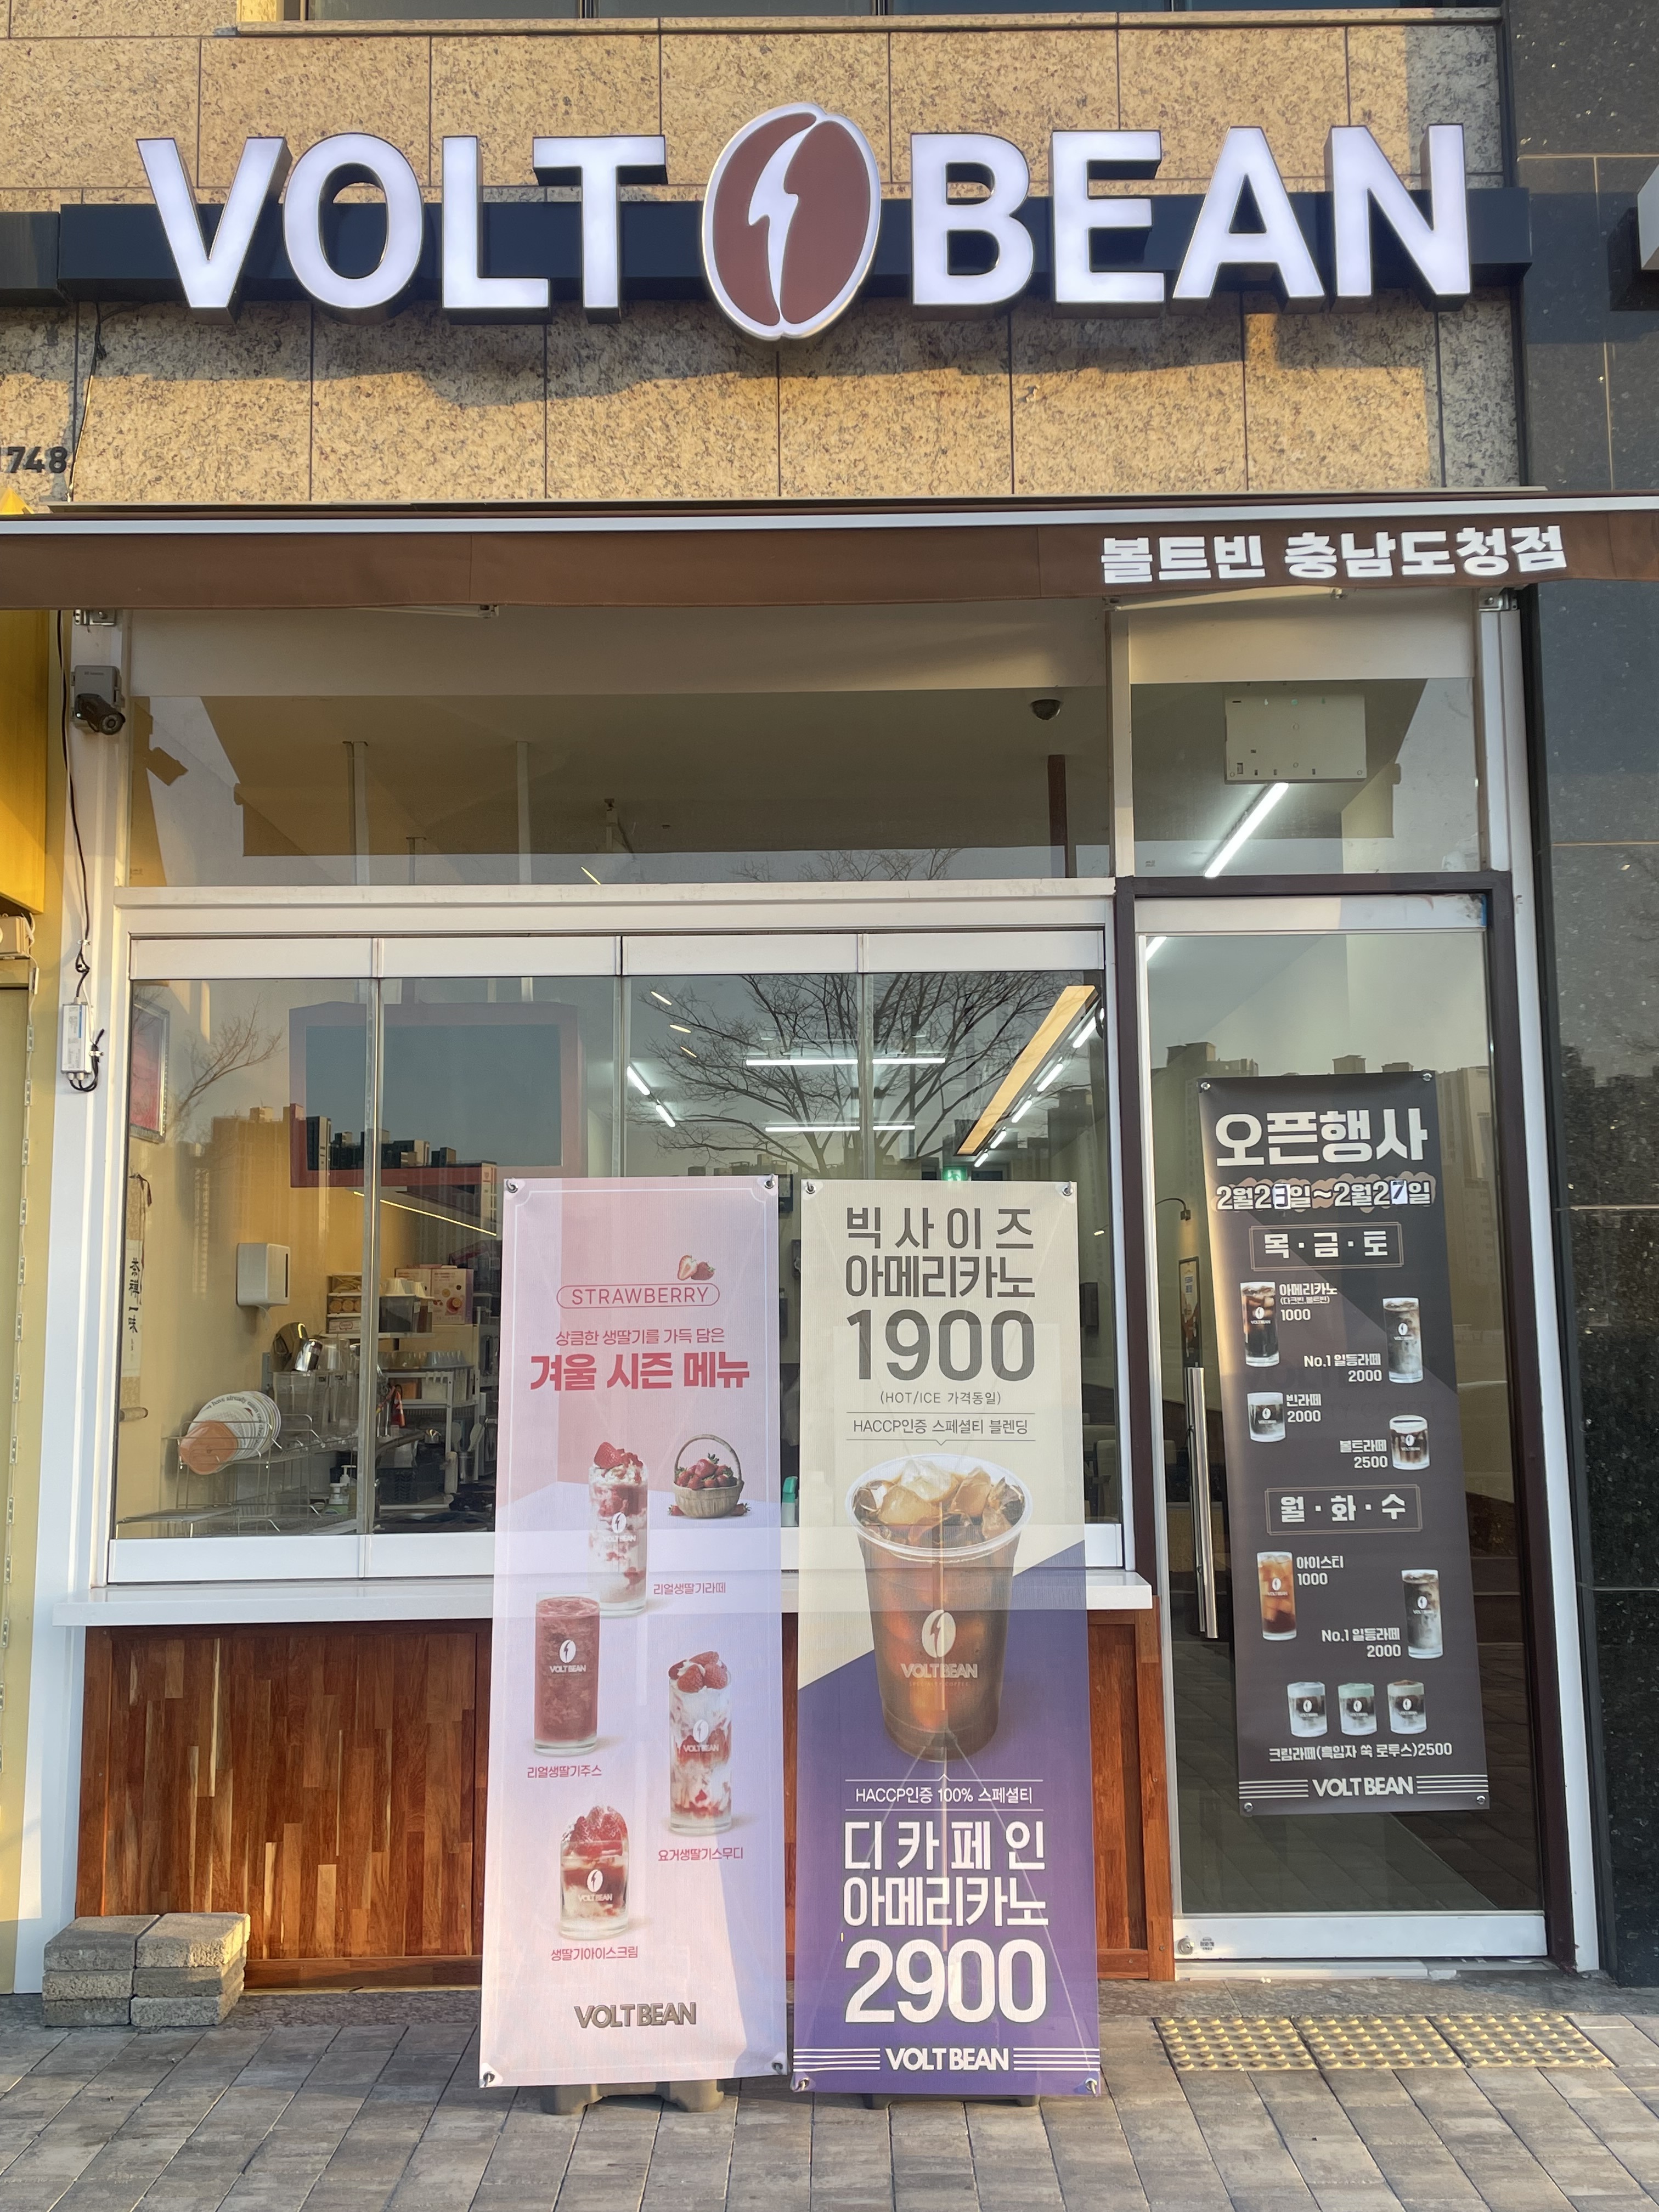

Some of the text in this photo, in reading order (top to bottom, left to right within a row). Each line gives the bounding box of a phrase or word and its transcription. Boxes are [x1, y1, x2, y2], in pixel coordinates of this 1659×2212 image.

[135, 124, 1472, 314] VOLT BEAN
[7, 446, 68, 473] 748
[1101, 525, 1568, 584] 볼트빈 충남도청점
[1215, 1108, 1429, 1167] 오픈행사
[845, 1255, 1036, 1299] 아메리카노
[571, 1286, 710, 1306] STRAWBERRY
[1279, 1282, 1338, 1296] 아메리카노
[1280, 1308, 1311, 1321] 1000
[555, 1327, 725, 1346] 상큼한 생딸기를 가득 담은
[846, 1308, 1035, 1381] 1900
[1304, 1353, 1381, 1368] No.1 일등라떼
[529, 1351, 751, 1392] 겨울 시즌 메뉴
[1347, 1369, 1383, 1383] 2000
[879, 1391, 1002, 1406] (HOT/ICE 가격동일)
[1286, 1393, 1322, 1407] 빈라떼
[1287, 1410, 1321, 1423] 2000
[854, 1418, 1029, 1436] HACCP인증 스페셜티 블렌딩
[1339, 1439, 1387, 1454] 볼트라떼
[1353, 1455, 1388, 1469] 2500
[1296, 1555, 1344, 1570] 아이스티
[1297, 1573, 1328, 1585] 1000
[653, 1582, 726, 1595] 리얼생딸기라떼
[1321, 1627, 1401, 1643] No.1 일등라떼
[1366, 1644, 1402, 1658] 2000
[1360, 1744, 1373, 1758] 쑥
[527, 1764, 602, 1779] 리얼생딸기주스
[855, 1786, 1032, 1805] HACCP인증 100% 스페셜티
[658, 1846, 744, 1862] 요거생딸기스무디
[843, 1876, 1049, 1927] 아메리카노
[550, 1945, 639, 1962] 생딸기아이스크림
[845, 1938, 1047, 2023] 2900
